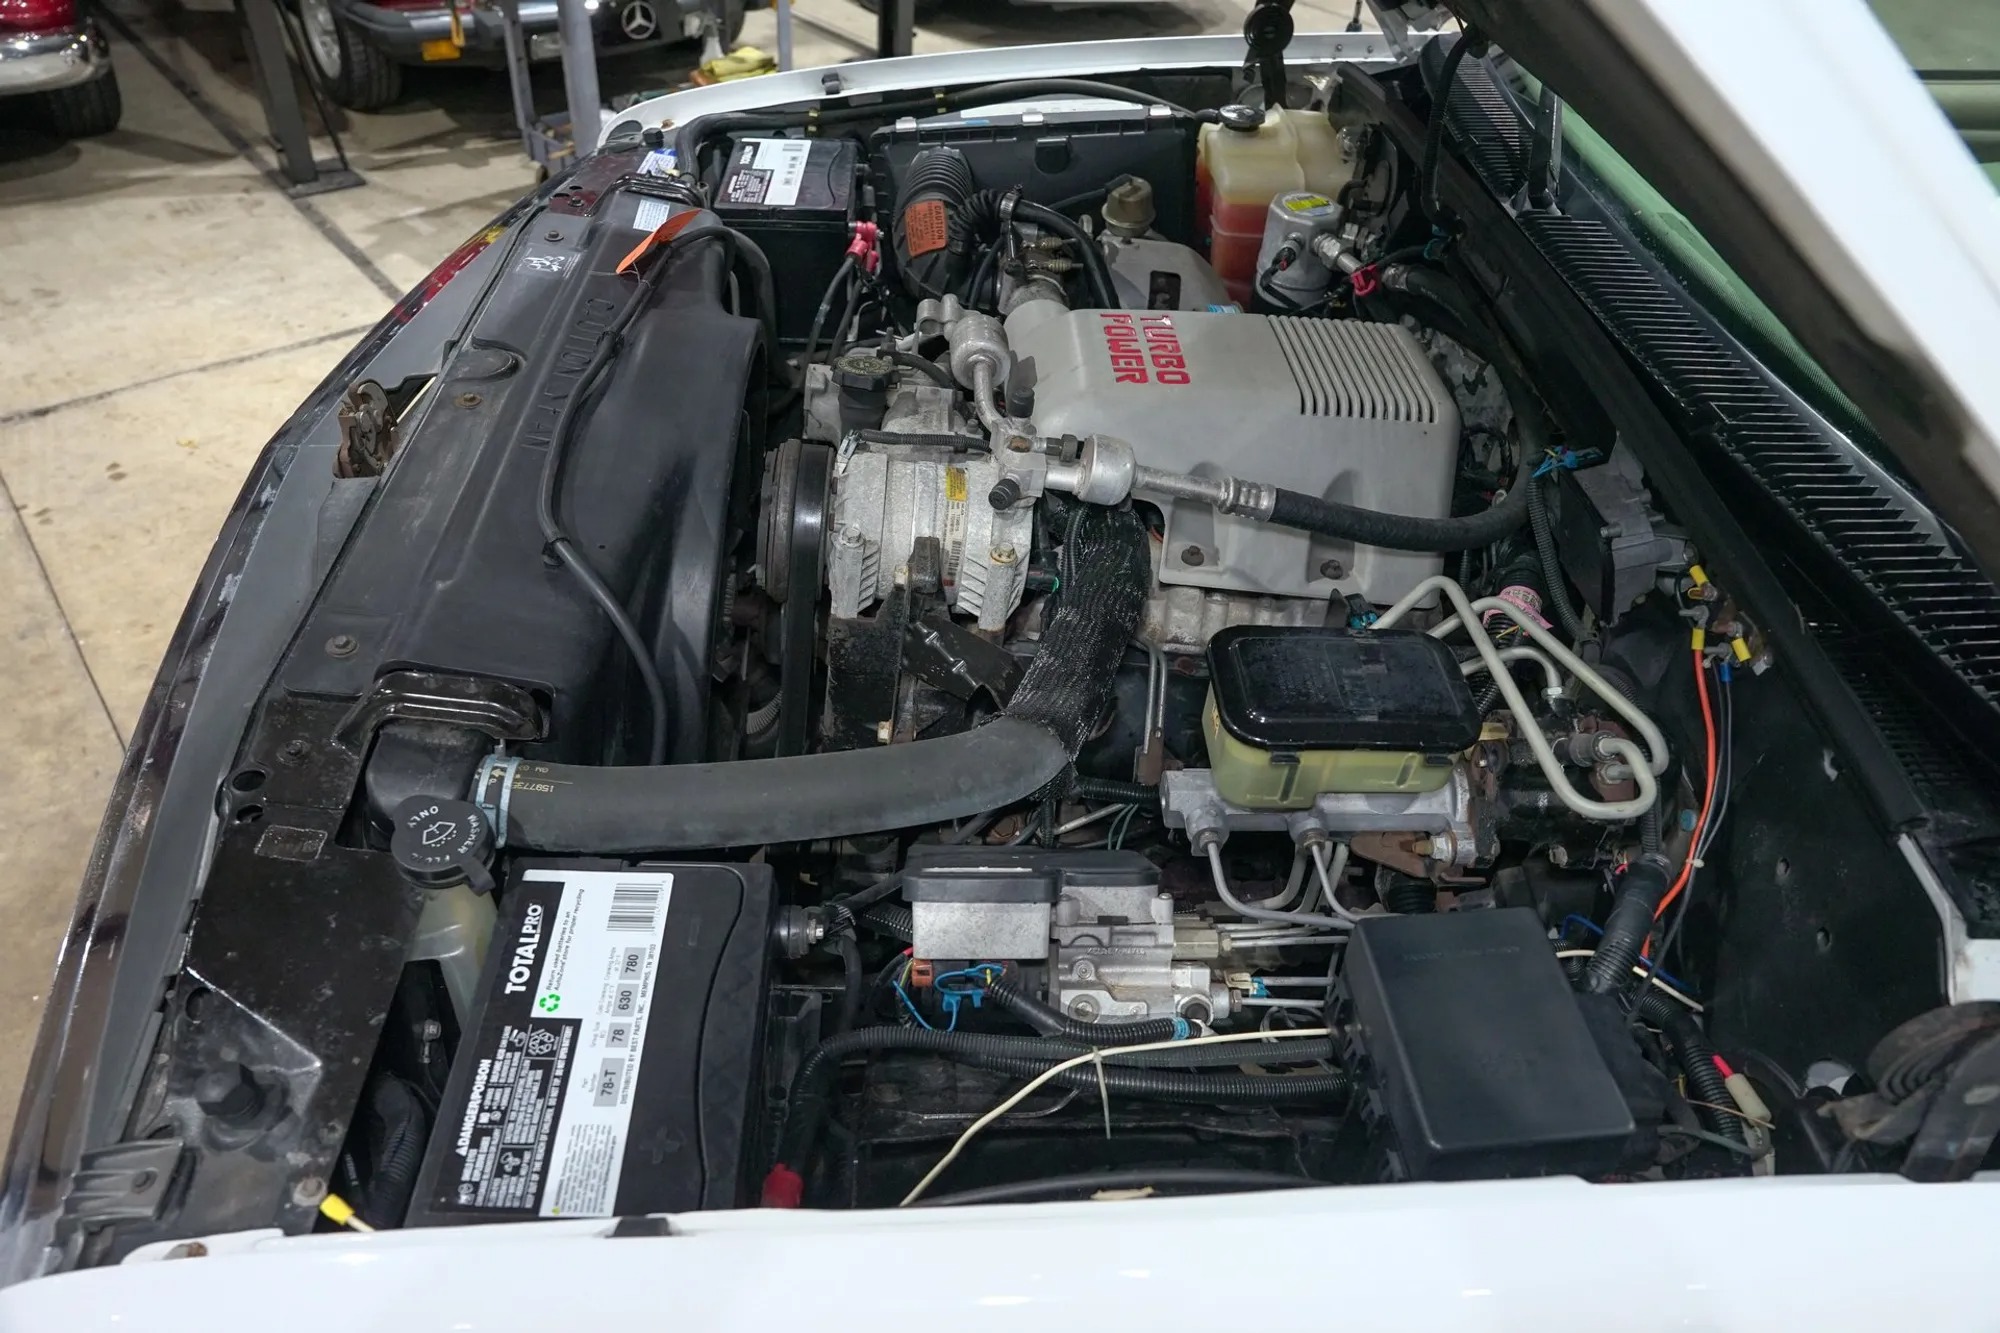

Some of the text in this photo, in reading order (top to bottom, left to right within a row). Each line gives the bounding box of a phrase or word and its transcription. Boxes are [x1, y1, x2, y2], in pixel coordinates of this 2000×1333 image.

[934, 205, 944, 240] CAUTION
[1099, 313, 1150, 384] POWER
[1140, 314, 1192, 385] TURBO
[407, 805, 439, 828] ONLY
[457, 814, 481, 854] WASHER
[504, 904, 542, 994] TOTALPRO
[625, 954, 638, 974] 780
[618, 990, 632, 1010] 630
[612, 1028, 625, 1043] 78
[628, 1037, 638, 1052] BEST
[600, 1070, 616, 1097] 78-T
